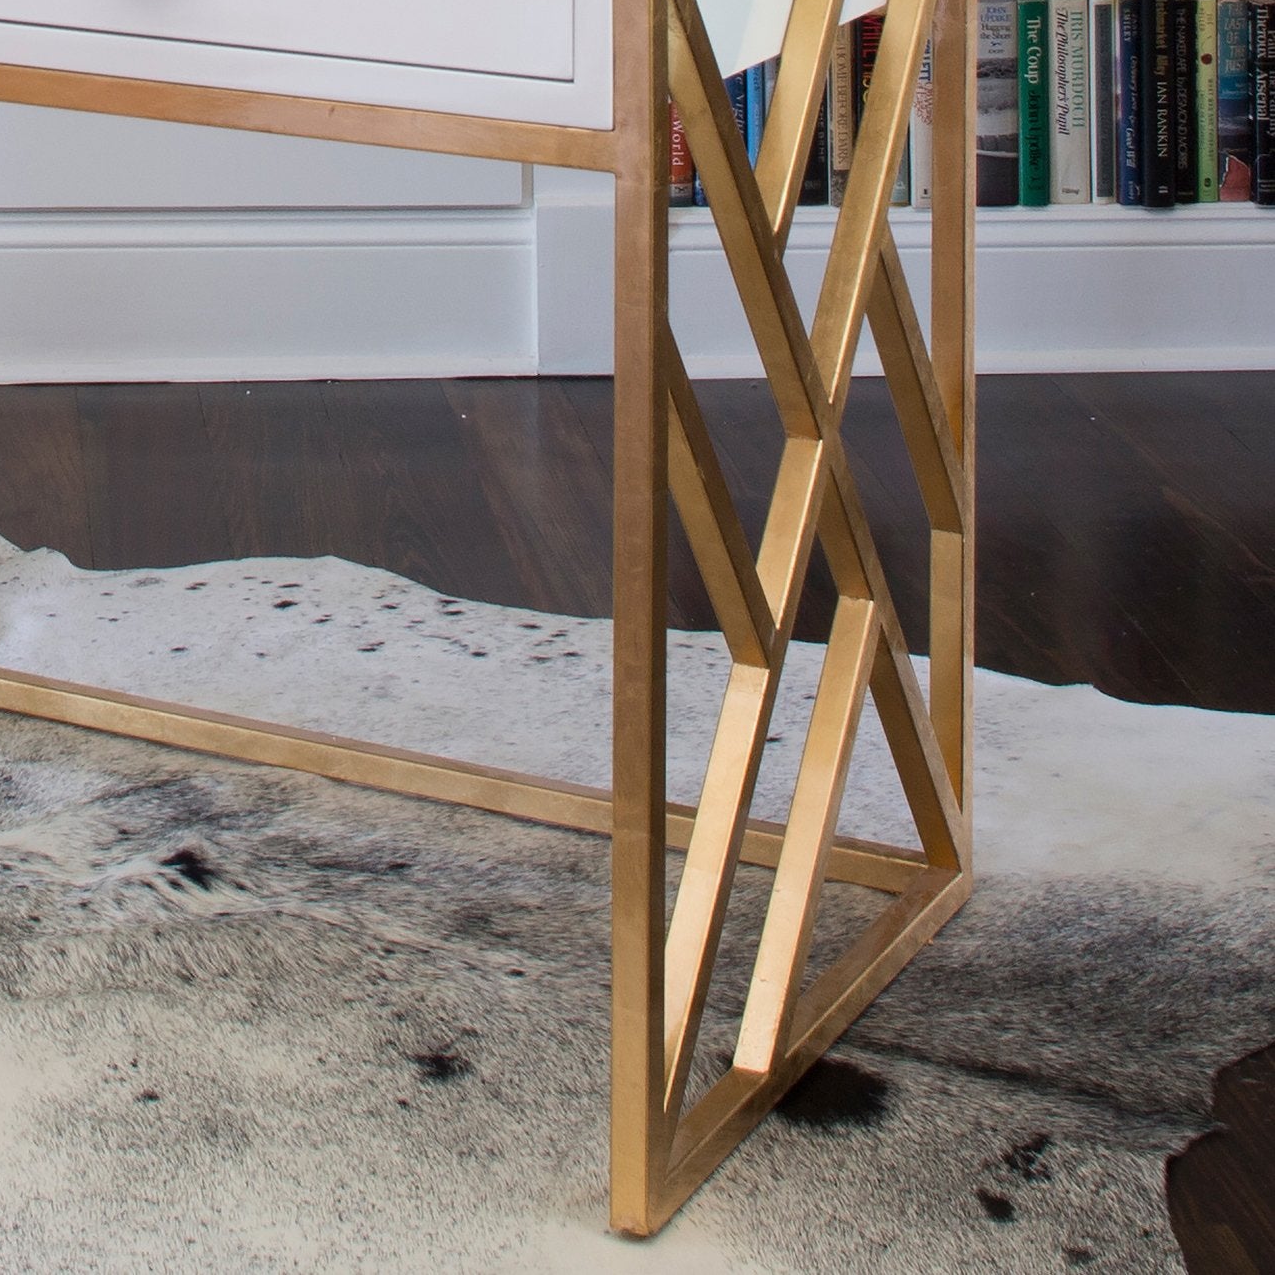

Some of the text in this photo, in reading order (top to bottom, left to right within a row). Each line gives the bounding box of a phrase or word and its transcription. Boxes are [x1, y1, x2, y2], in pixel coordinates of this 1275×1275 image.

[1055, 8, 1070, 135] The Philosopher's Pupil
[1070, 10, 1084, 127] IRIS MURDOCH
[1256, 5, 1269, 58] Theroux
[836, 46, 850, 165] HOME BEFORE DARK
[1024, 16, 1042, 169] The Coup John Updike
[1157, 81, 1168, 157] IAN RANKIN
[1256, 68, 1269, 121] Arsenal
[672, 120, 684, 166] World
